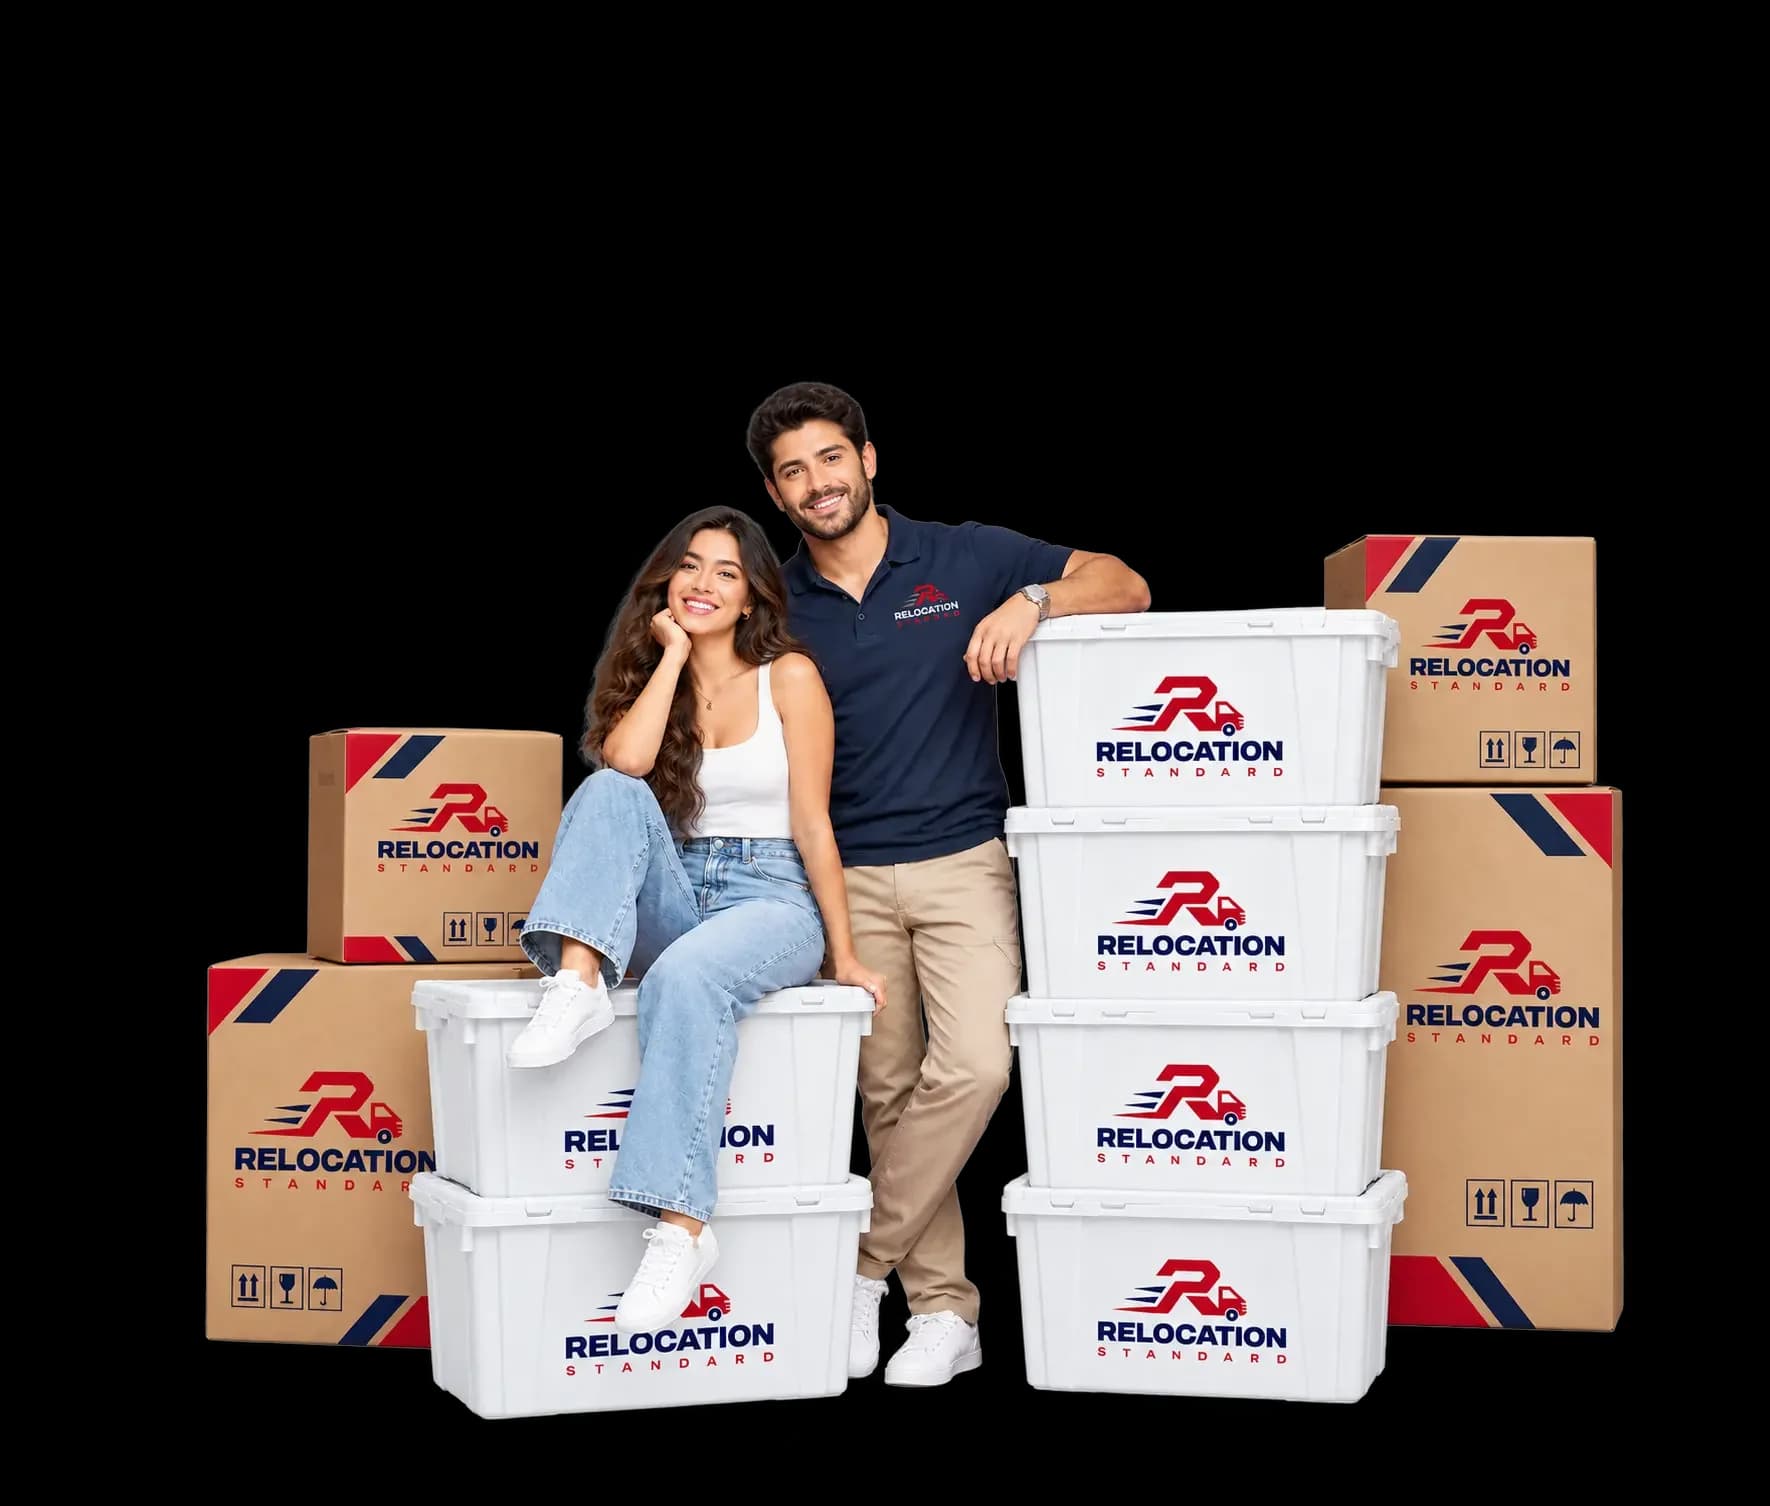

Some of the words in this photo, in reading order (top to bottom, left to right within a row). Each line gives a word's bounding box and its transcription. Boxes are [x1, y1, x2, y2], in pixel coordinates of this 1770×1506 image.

[894, 600, 959, 621] RELOCATION
[1409, 657, 1570, 677] RELOCATION
[1410, 680, 1570, 692] STANDARD
[1096, 740, 1283, 762] RELOCATION
[1096, 767, 1283, 777] STANDARD
[377, 840, 539, 859] RELOCATION
[377, 863, 539, 873] STANDARD
[1097, 935, 1285, 956] RELOCATION
[1097, 961, 1285, 972] STANDARD
[1406, 1004, 1600, 1029] RELOCATION
[1407, 1032, 1600, 1046] STANDARD
[564, 1124, 775, 1153] RELION
[1097, 1127, 1285, 1152] RELOCATION
[234, 1147, 437, 1174] RELOCATION
[564, 1152, 775, 1169] STRD
[1097, 1153, 1285, 1168] STANDARD
[234, 1177, 410, 1192] STANDAR
[565, 1322, 775, 1360] RELOCATION
[1097, 1321, 1287, 1348] RELOCATION
[566, 1352, 775, 1376] STANDARD
[1097, 1346, 1287, 1364] STANDARD
